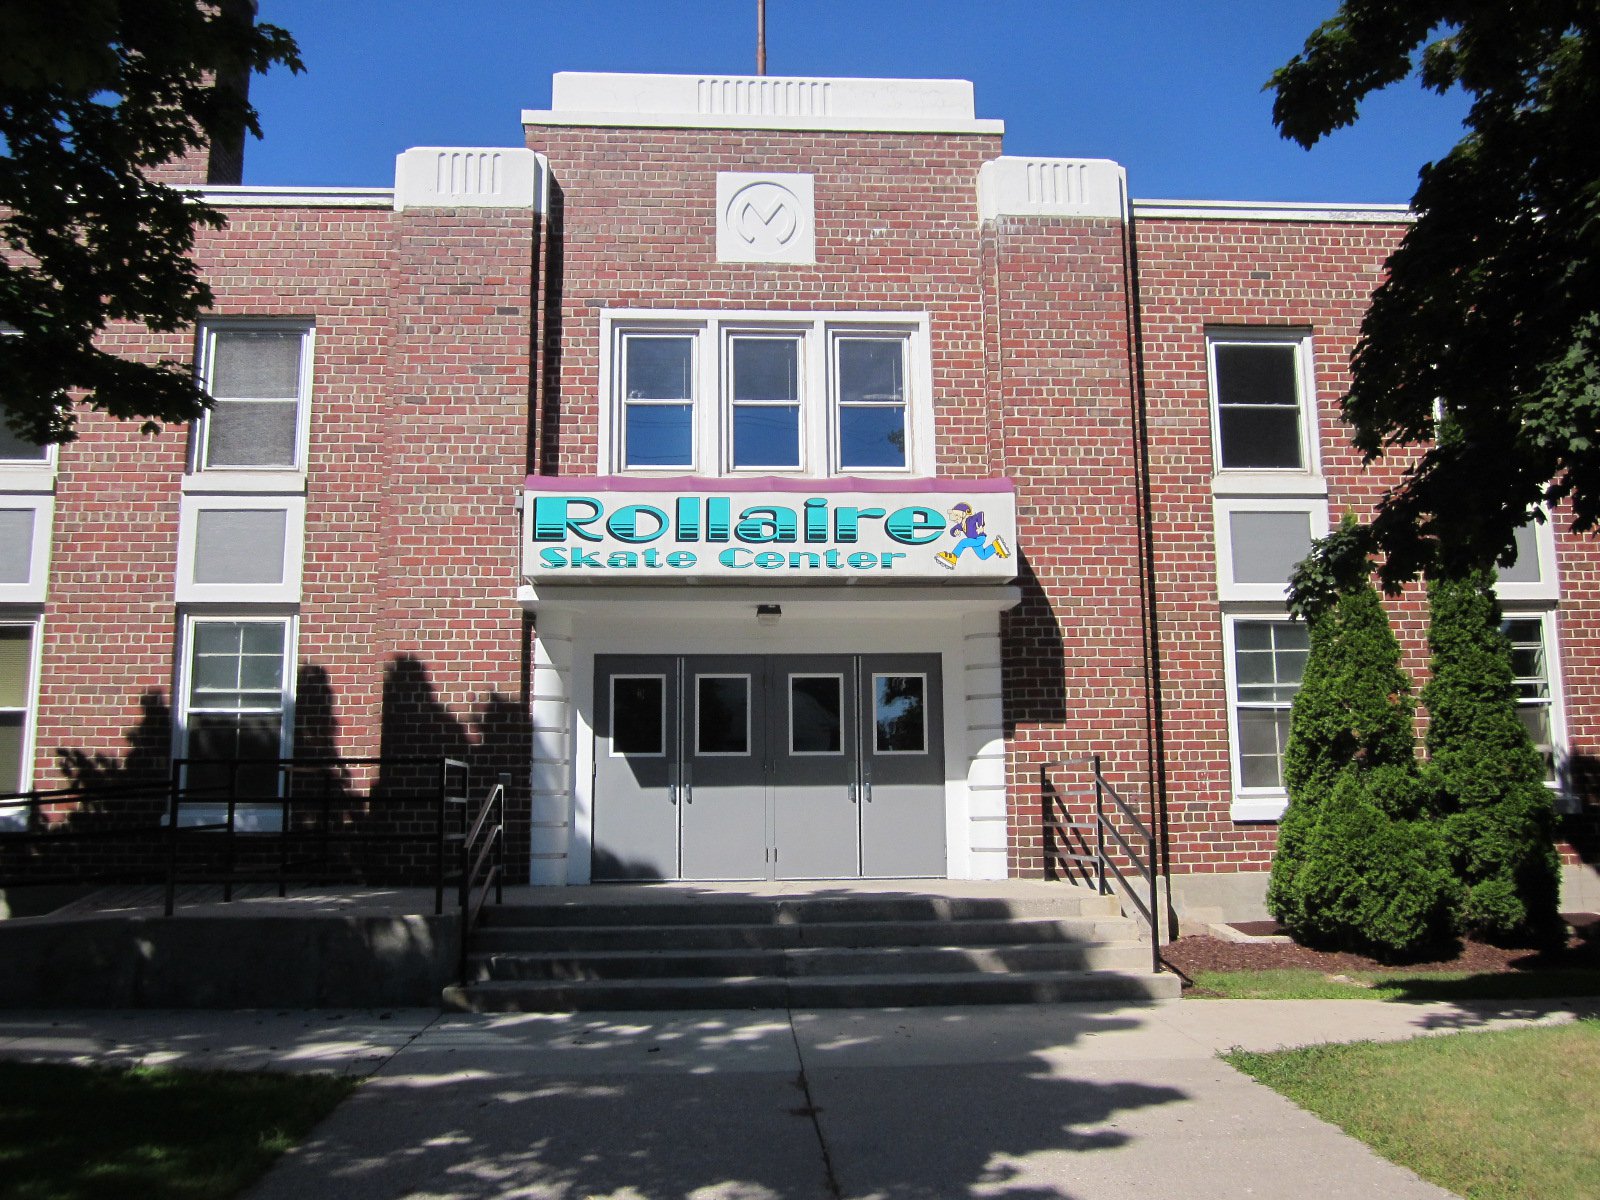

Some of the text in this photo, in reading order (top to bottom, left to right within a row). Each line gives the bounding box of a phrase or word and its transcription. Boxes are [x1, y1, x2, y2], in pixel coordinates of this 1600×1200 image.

[532, 496, 947, 545] Rollaire
[539, 547, 907, 569] Skate Center
